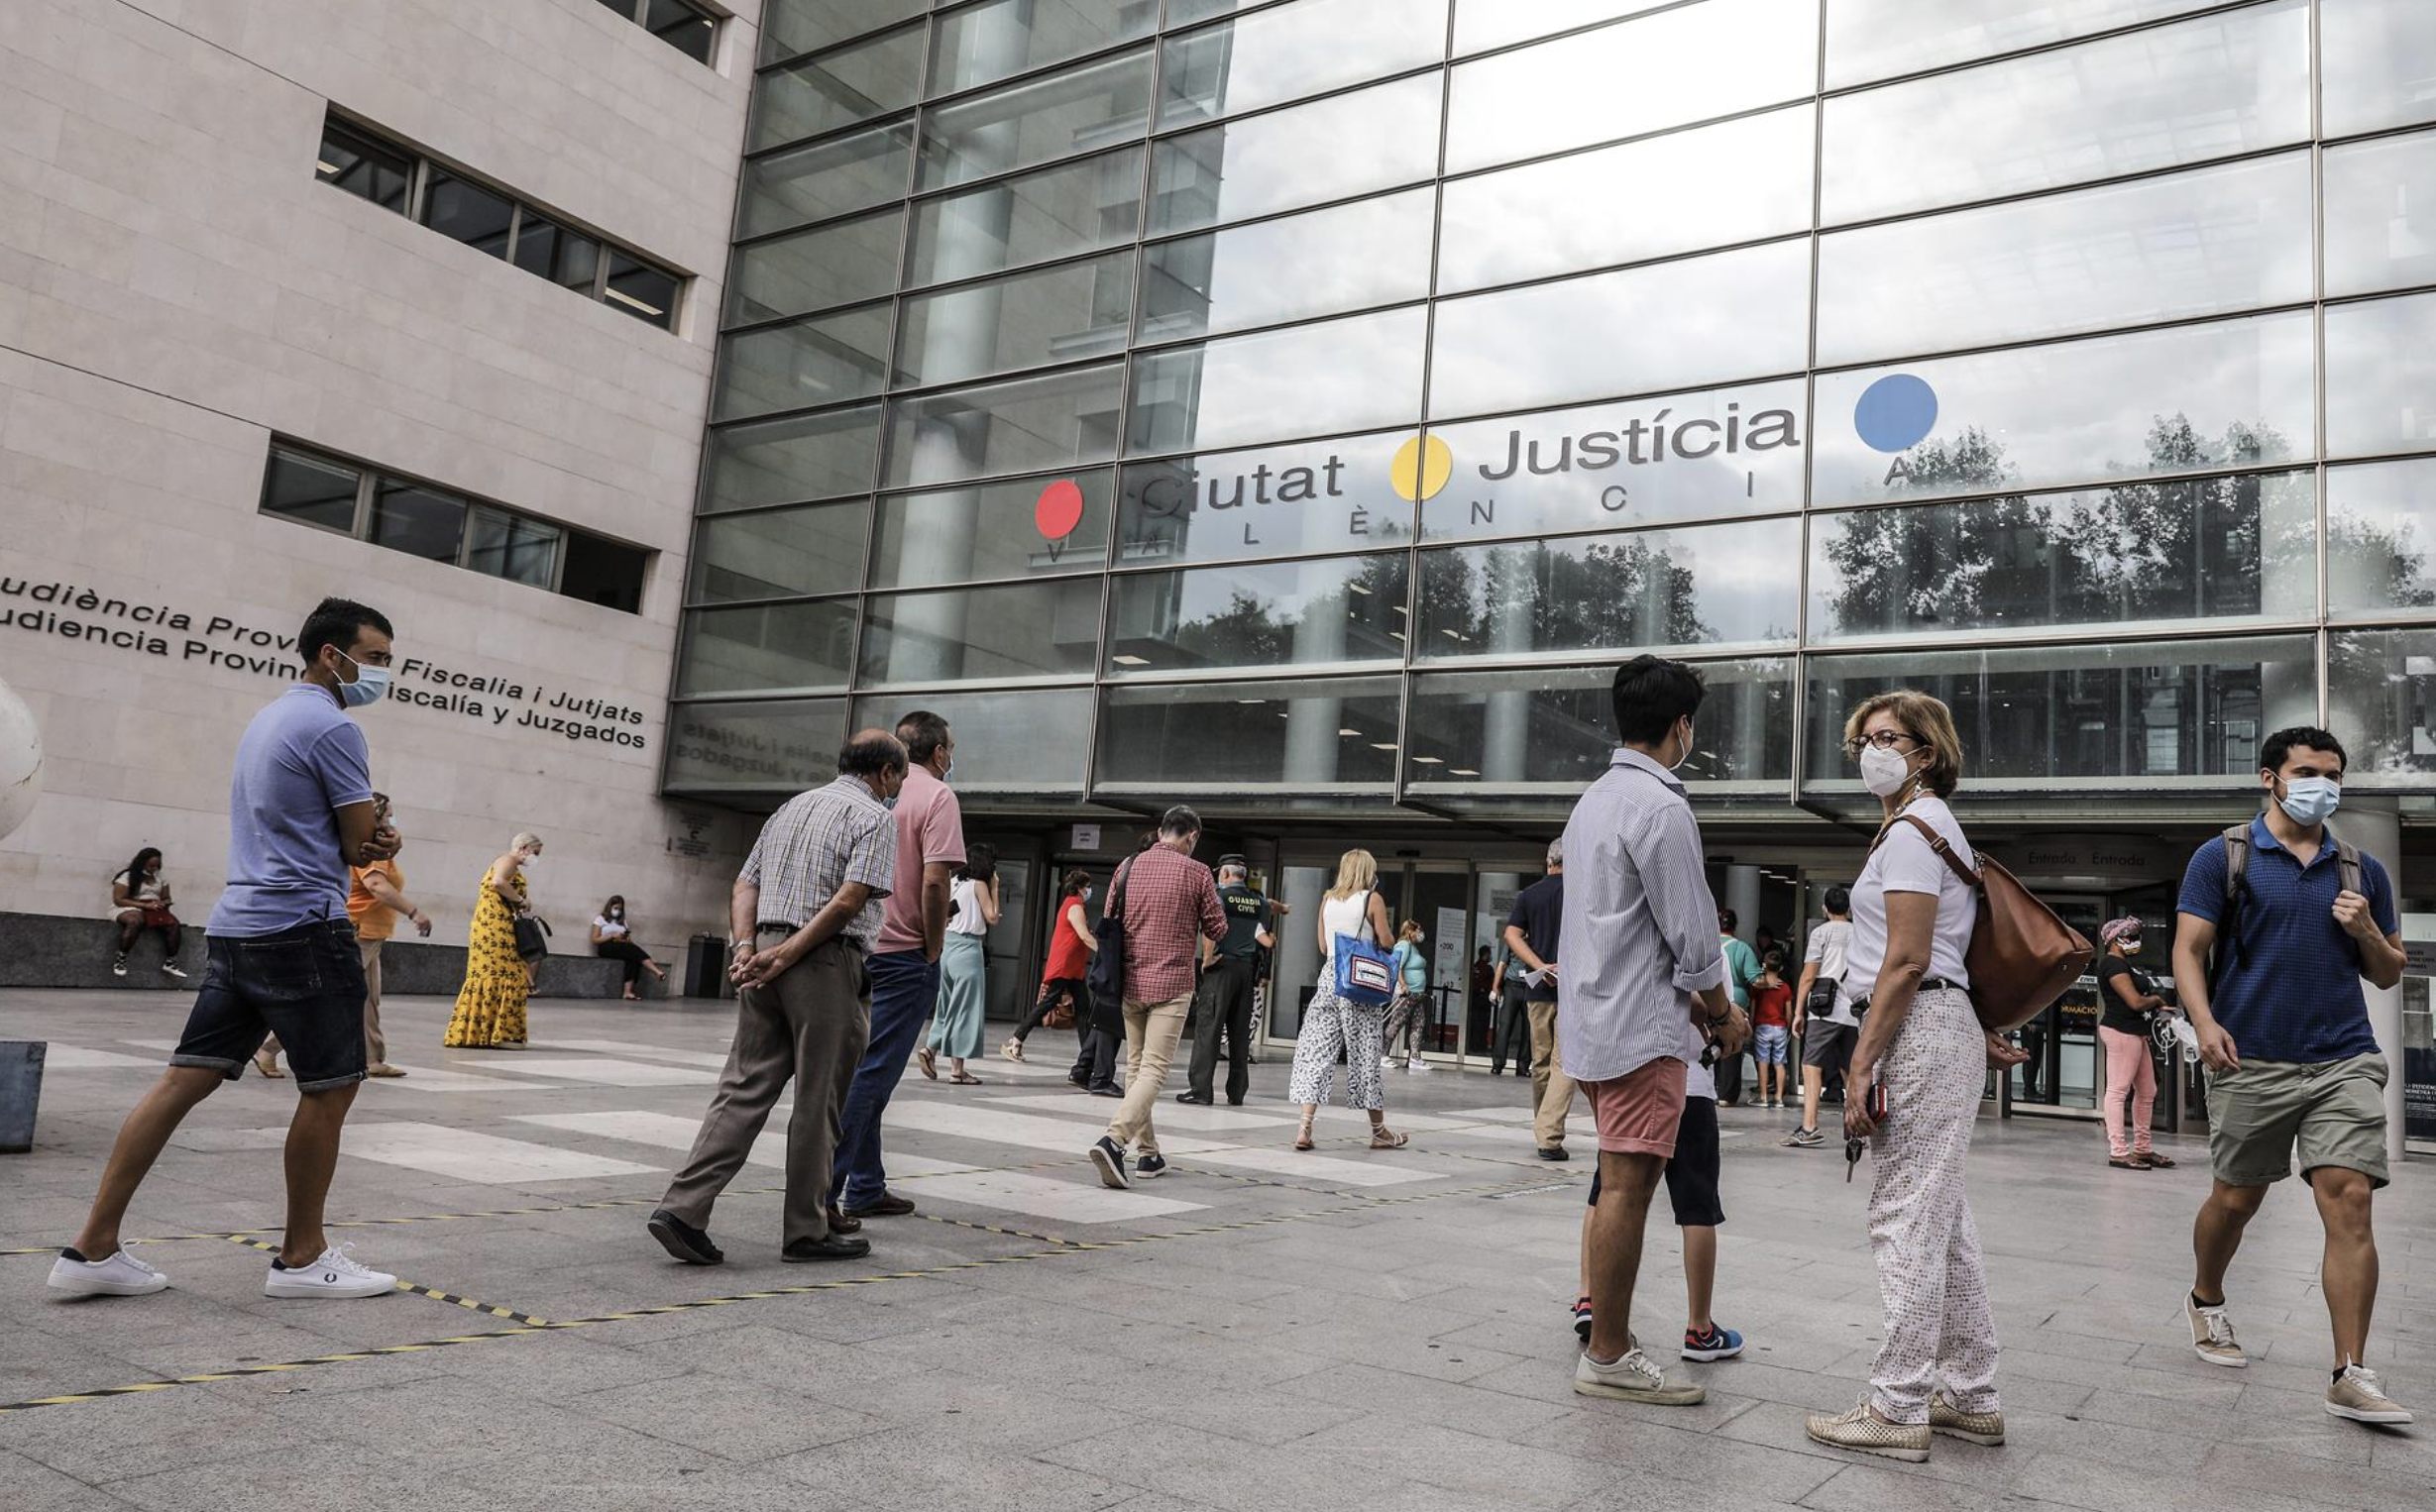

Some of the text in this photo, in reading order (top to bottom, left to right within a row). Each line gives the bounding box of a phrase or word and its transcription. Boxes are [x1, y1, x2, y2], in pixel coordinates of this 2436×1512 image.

[1141, 402, 1801, 518] Ciutat Justícia
[0, 577, 191, 631] udiència
[400, 658, 523, 700] Fiscalia
[533, 686, 542, 703] i
[549, 692, 643, 724] Jutjats
[0, 608, 167, 656] udiencia
[387, 681, 484, 717] iscalía
[493, 705, 509, 725] y
[517, 709, 645, 749] Juzgados
[2029, 851, 2145, 866] Entrada Entrada
[1228, 895, 1261, 907] GUARDIA
[1238, 904, 1255, 915] CIVIL
